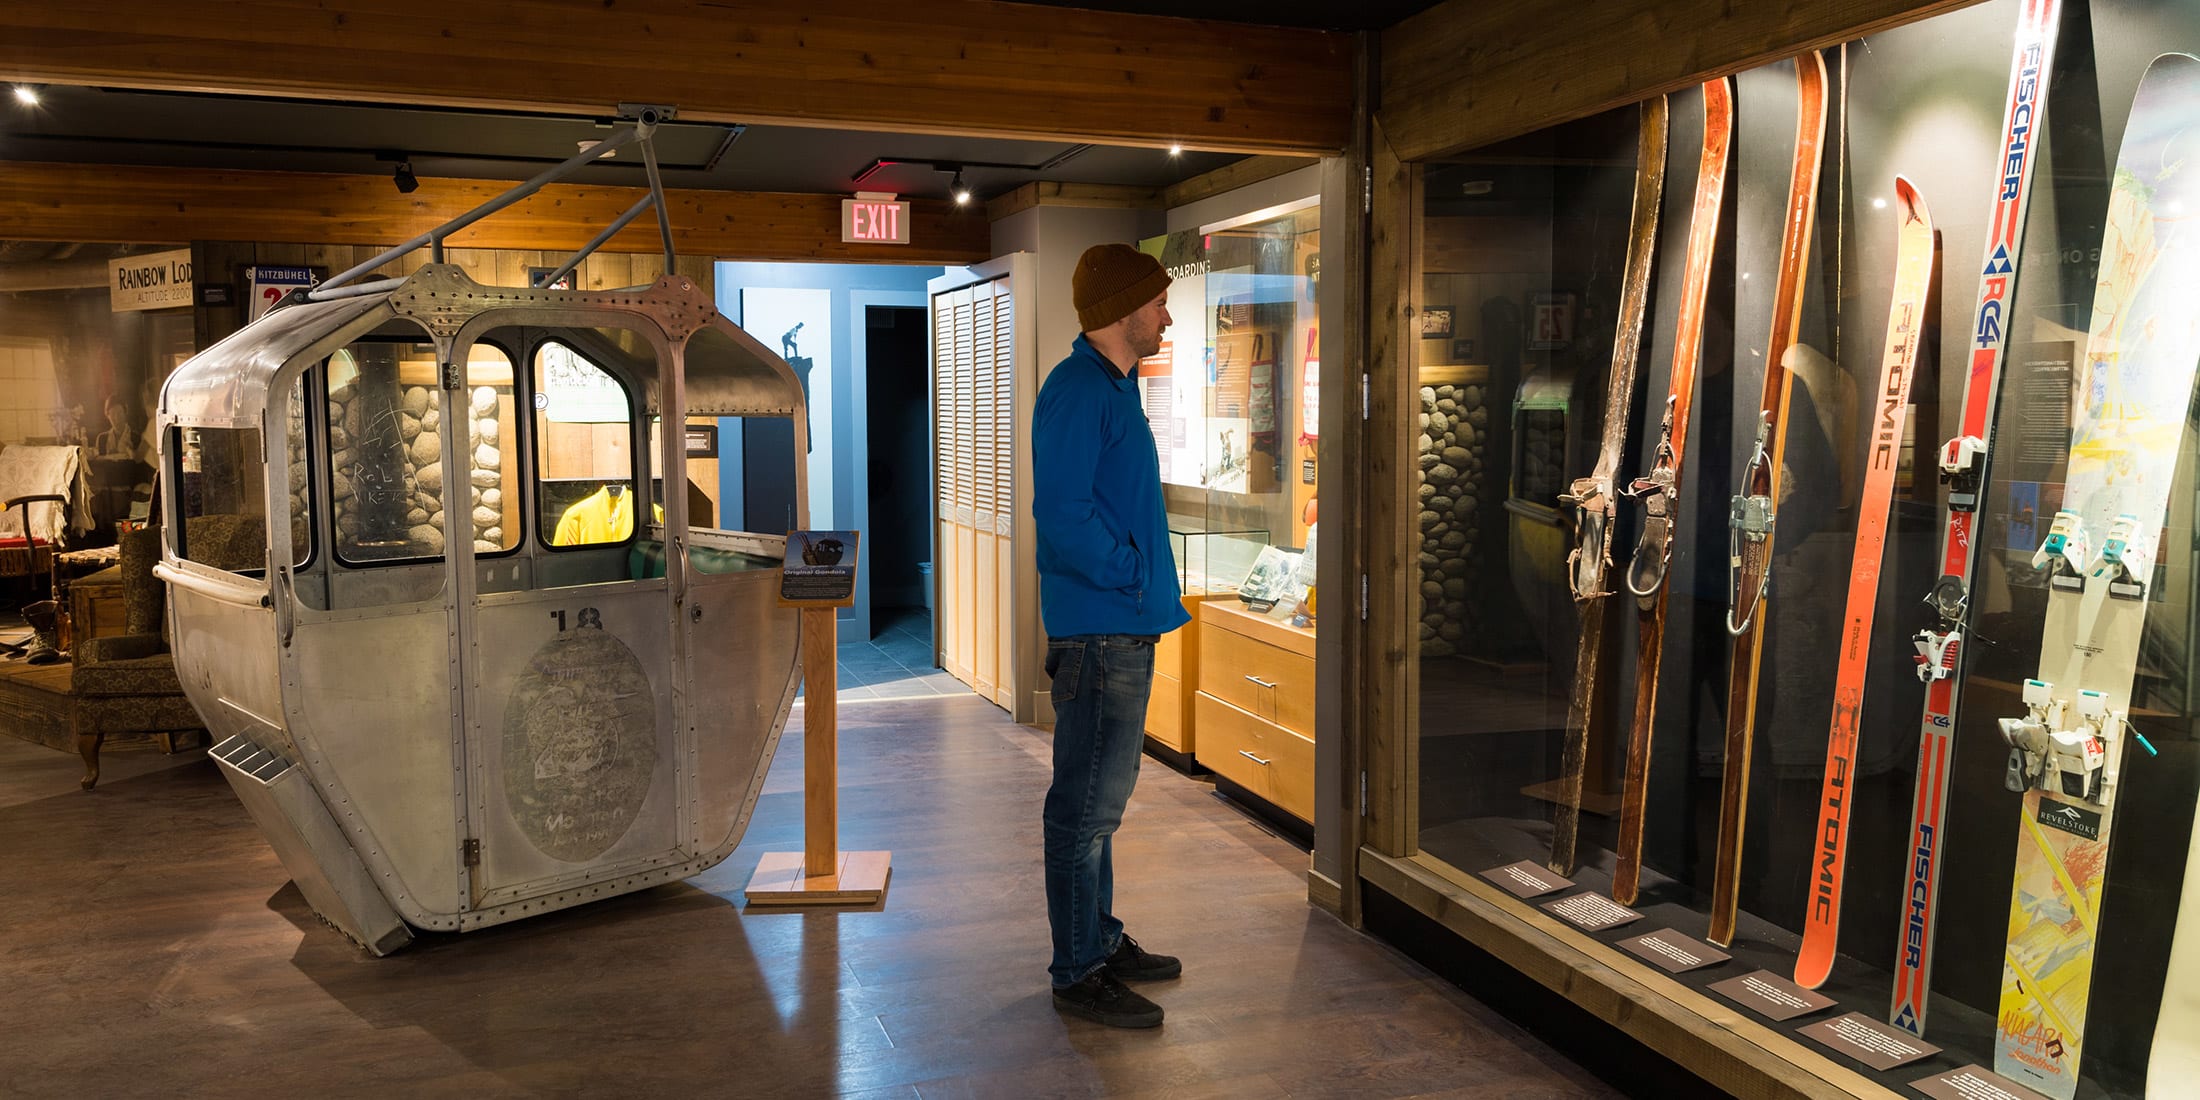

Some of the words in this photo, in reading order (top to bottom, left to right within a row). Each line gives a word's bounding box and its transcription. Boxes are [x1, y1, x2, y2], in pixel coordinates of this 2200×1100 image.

[2001, 41, 2041, 201] FISCHER
[853, 203, 901, 240] EXIT
[119, 265, 167, 291] RAINBOW
[258, 269, 308, 281] KITZBÜHEL
[137, 289, 169, 304] ALTITUDE
[1976, 277, 2007, 349] RC4
[1875, 302, 1913, 471] ATOMIC
[1925, 714, 1951, 728] RC4
[1815, 756, 1847, 925] ATOMIC
[2040, 811, 2097, 835] REVELSTOKE
[1905, 822, 1934, 970] FISCHER
